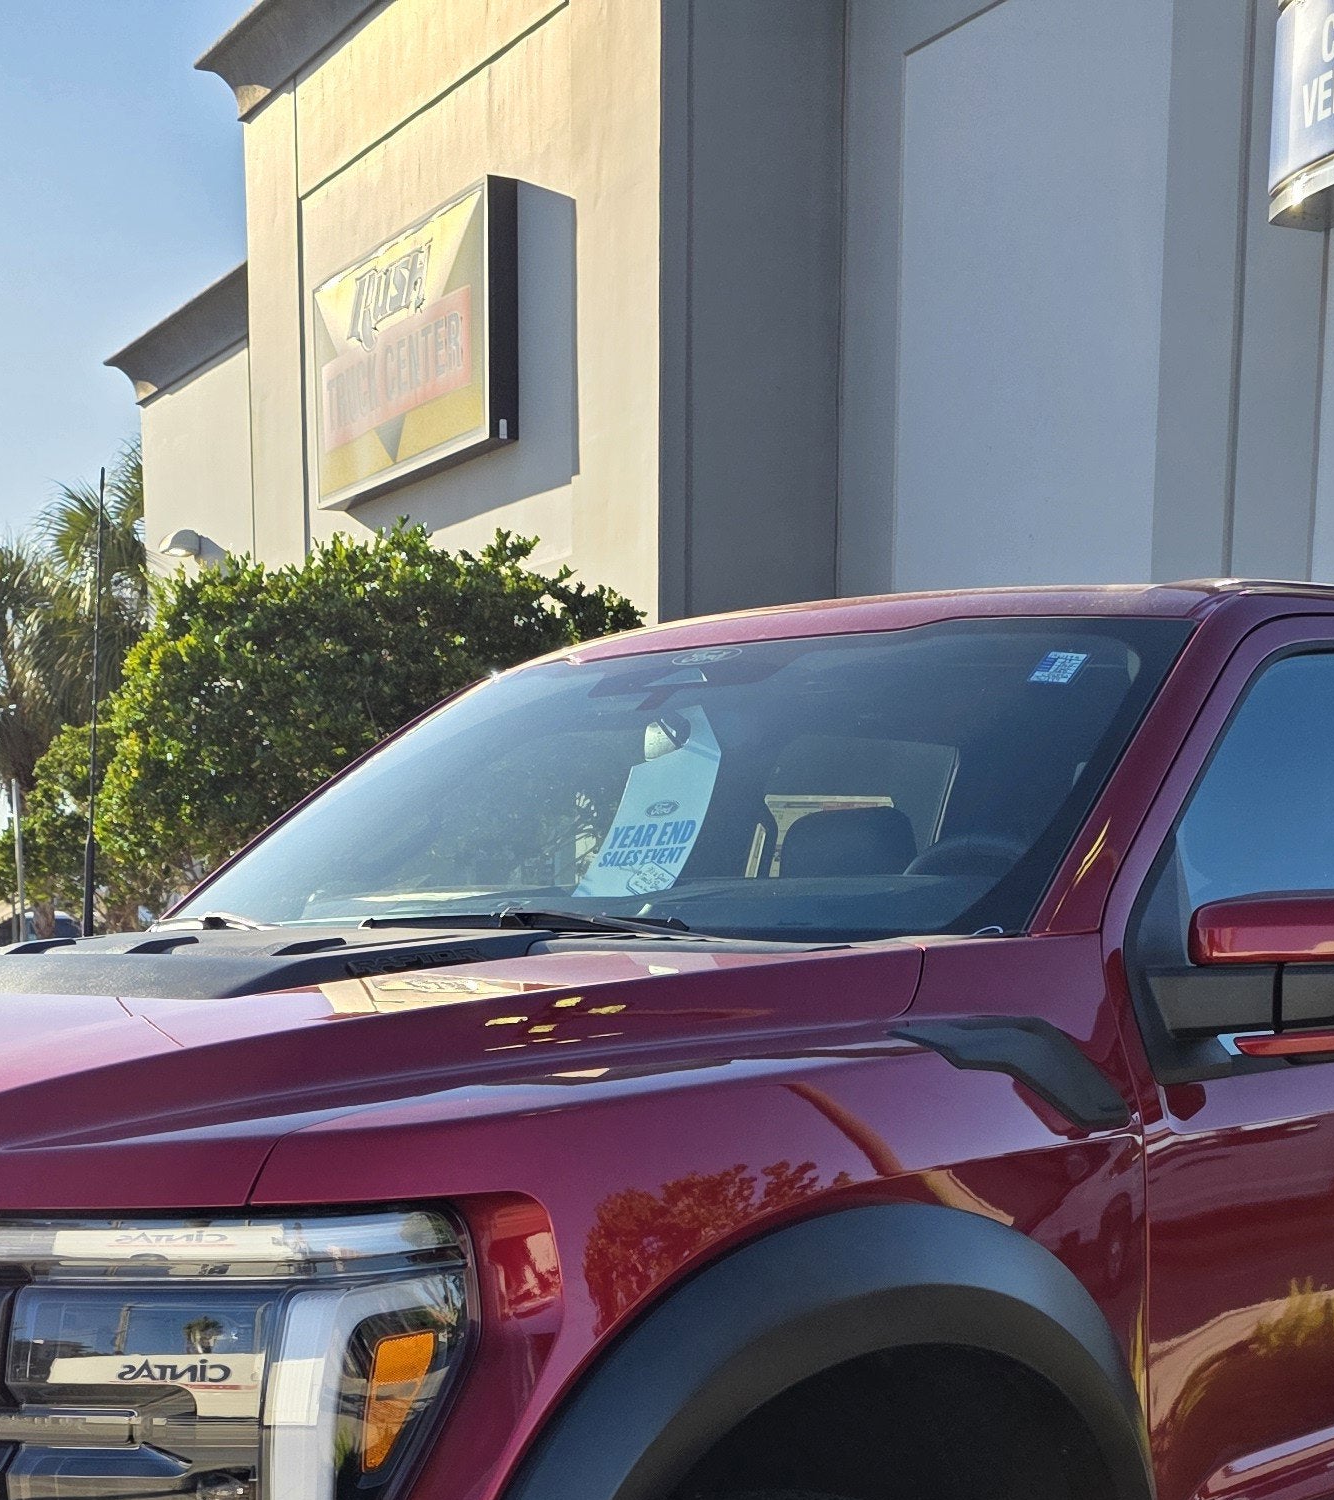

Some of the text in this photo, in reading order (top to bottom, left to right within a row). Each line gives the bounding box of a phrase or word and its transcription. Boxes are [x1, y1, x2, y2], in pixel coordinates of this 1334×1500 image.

[326, 310, 463, 433] TRUCK CENTER
[608, 819, 697, 849] YEAR END
[598, 846, 686, 868] SALES EVENT
